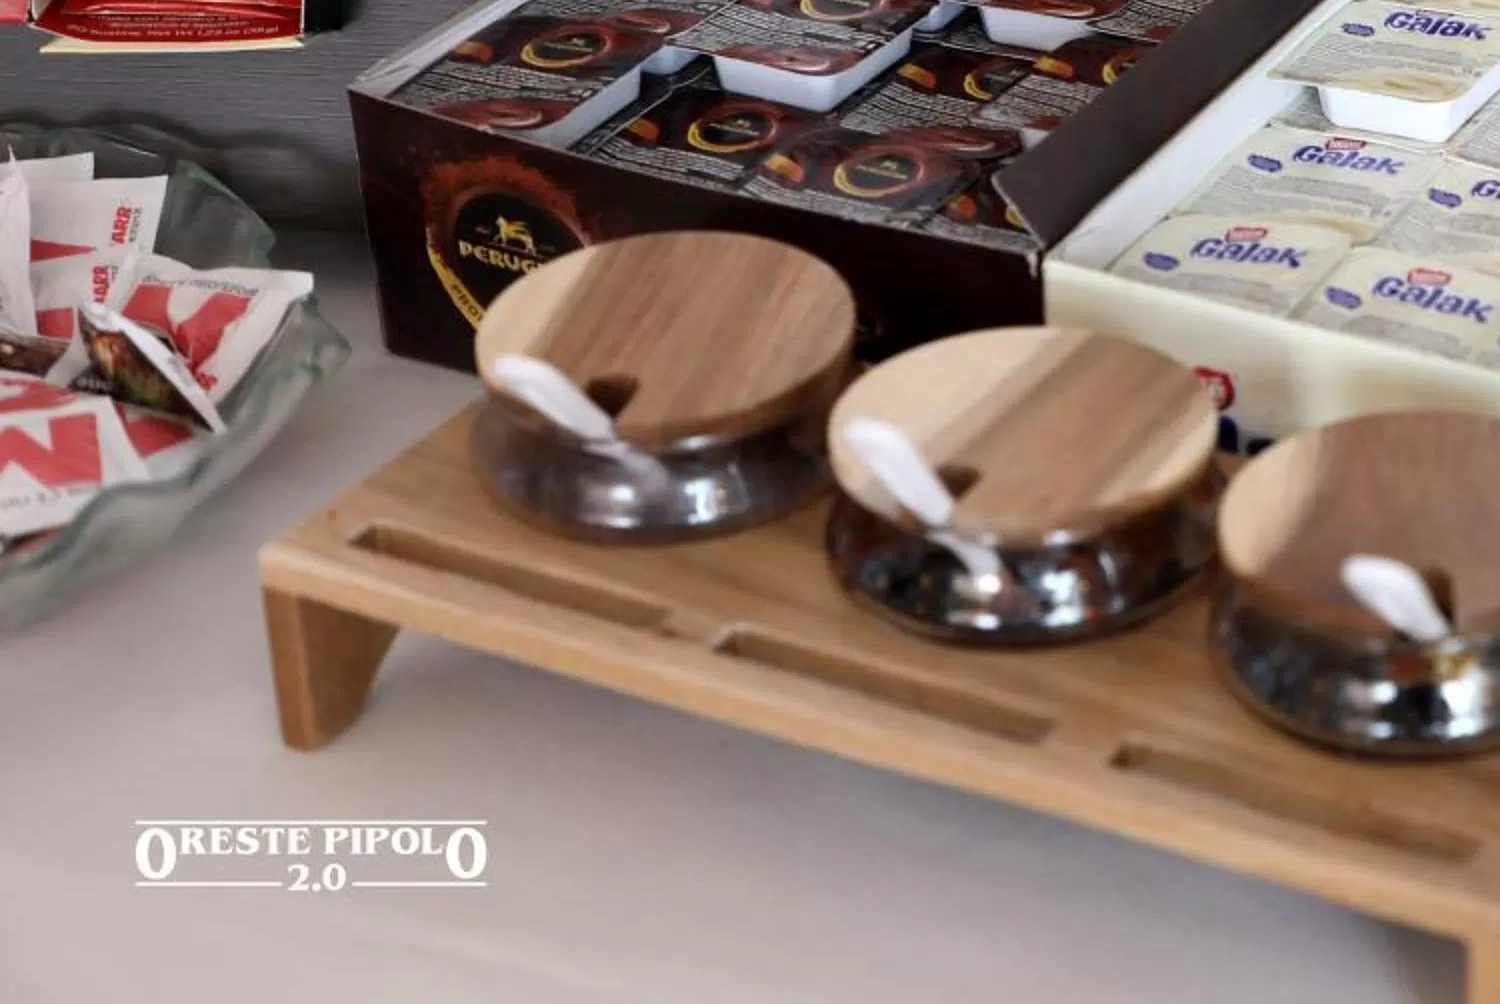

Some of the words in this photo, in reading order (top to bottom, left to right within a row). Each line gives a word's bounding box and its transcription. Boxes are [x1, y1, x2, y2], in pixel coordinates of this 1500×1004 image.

[1384, 10, 1492, 40] Galak
[1292, 145, 1405, 176] Galak
[458, 239, 547, 275] PERUG
[1190, 238, 1308, 269] Galak
[1370, 276, 1494, 324] Galak
